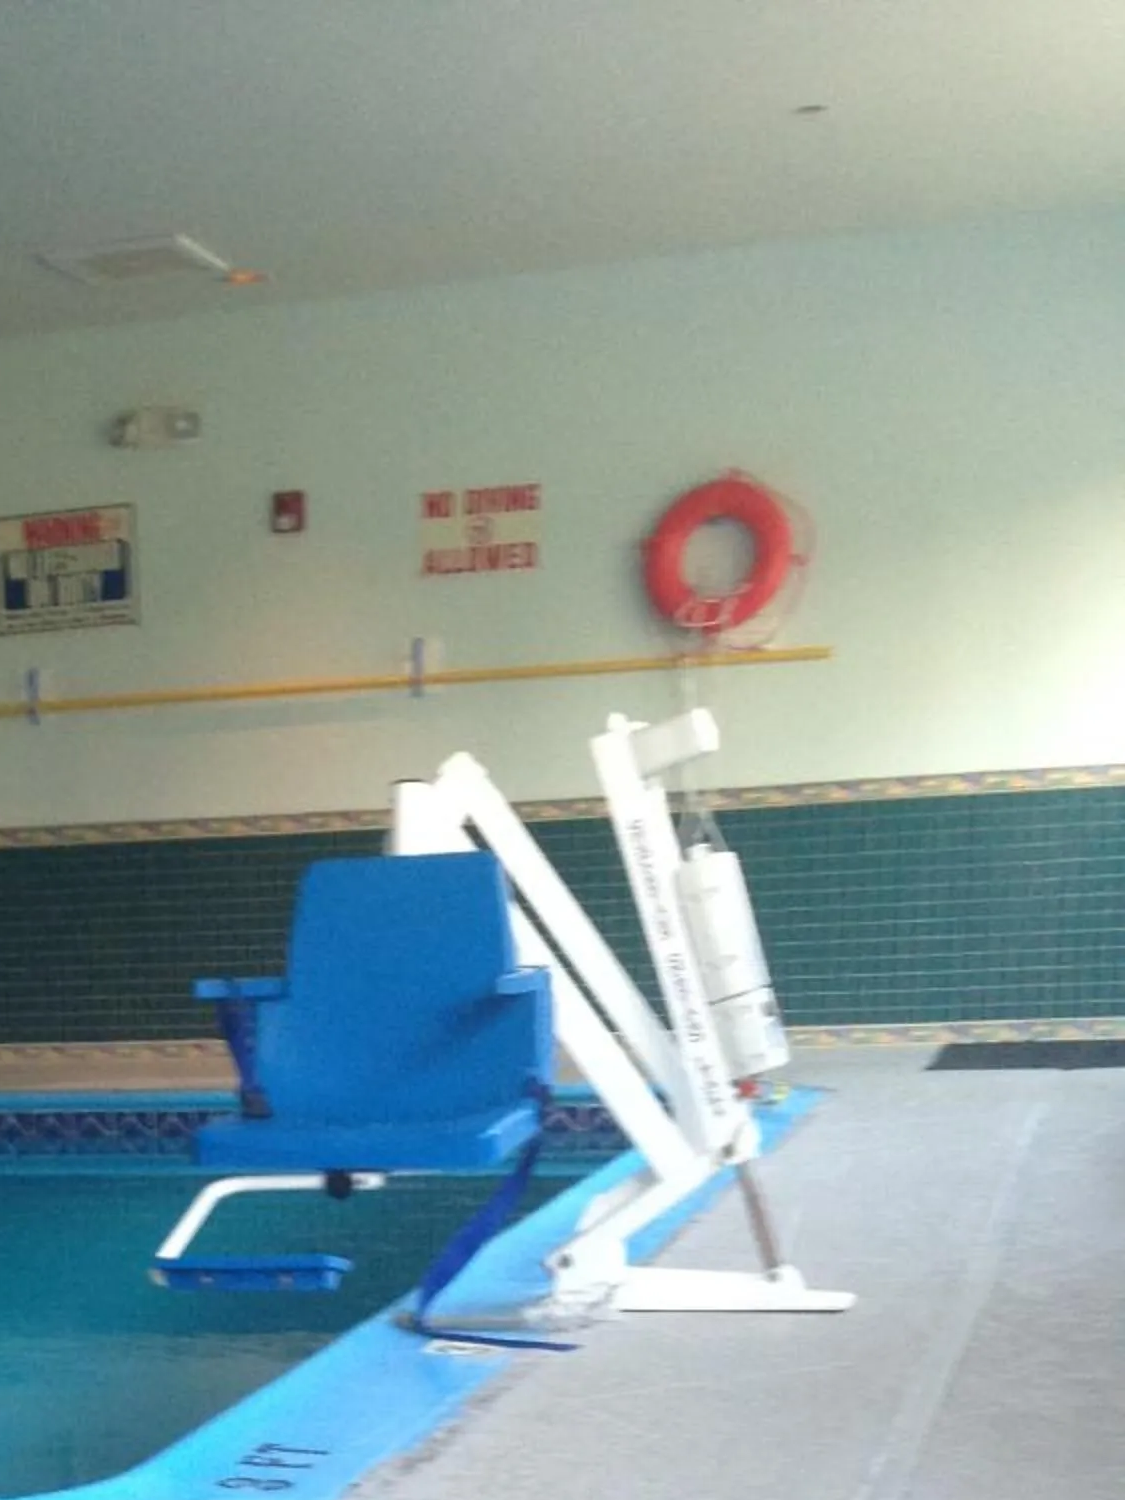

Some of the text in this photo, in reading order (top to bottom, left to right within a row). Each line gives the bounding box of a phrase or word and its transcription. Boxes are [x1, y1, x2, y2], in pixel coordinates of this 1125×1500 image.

[422, 484, 540, 519] NO DIVING
[421, 541, 539, 577] ALLOWED
[236, 1442, 329, 1469] FT
